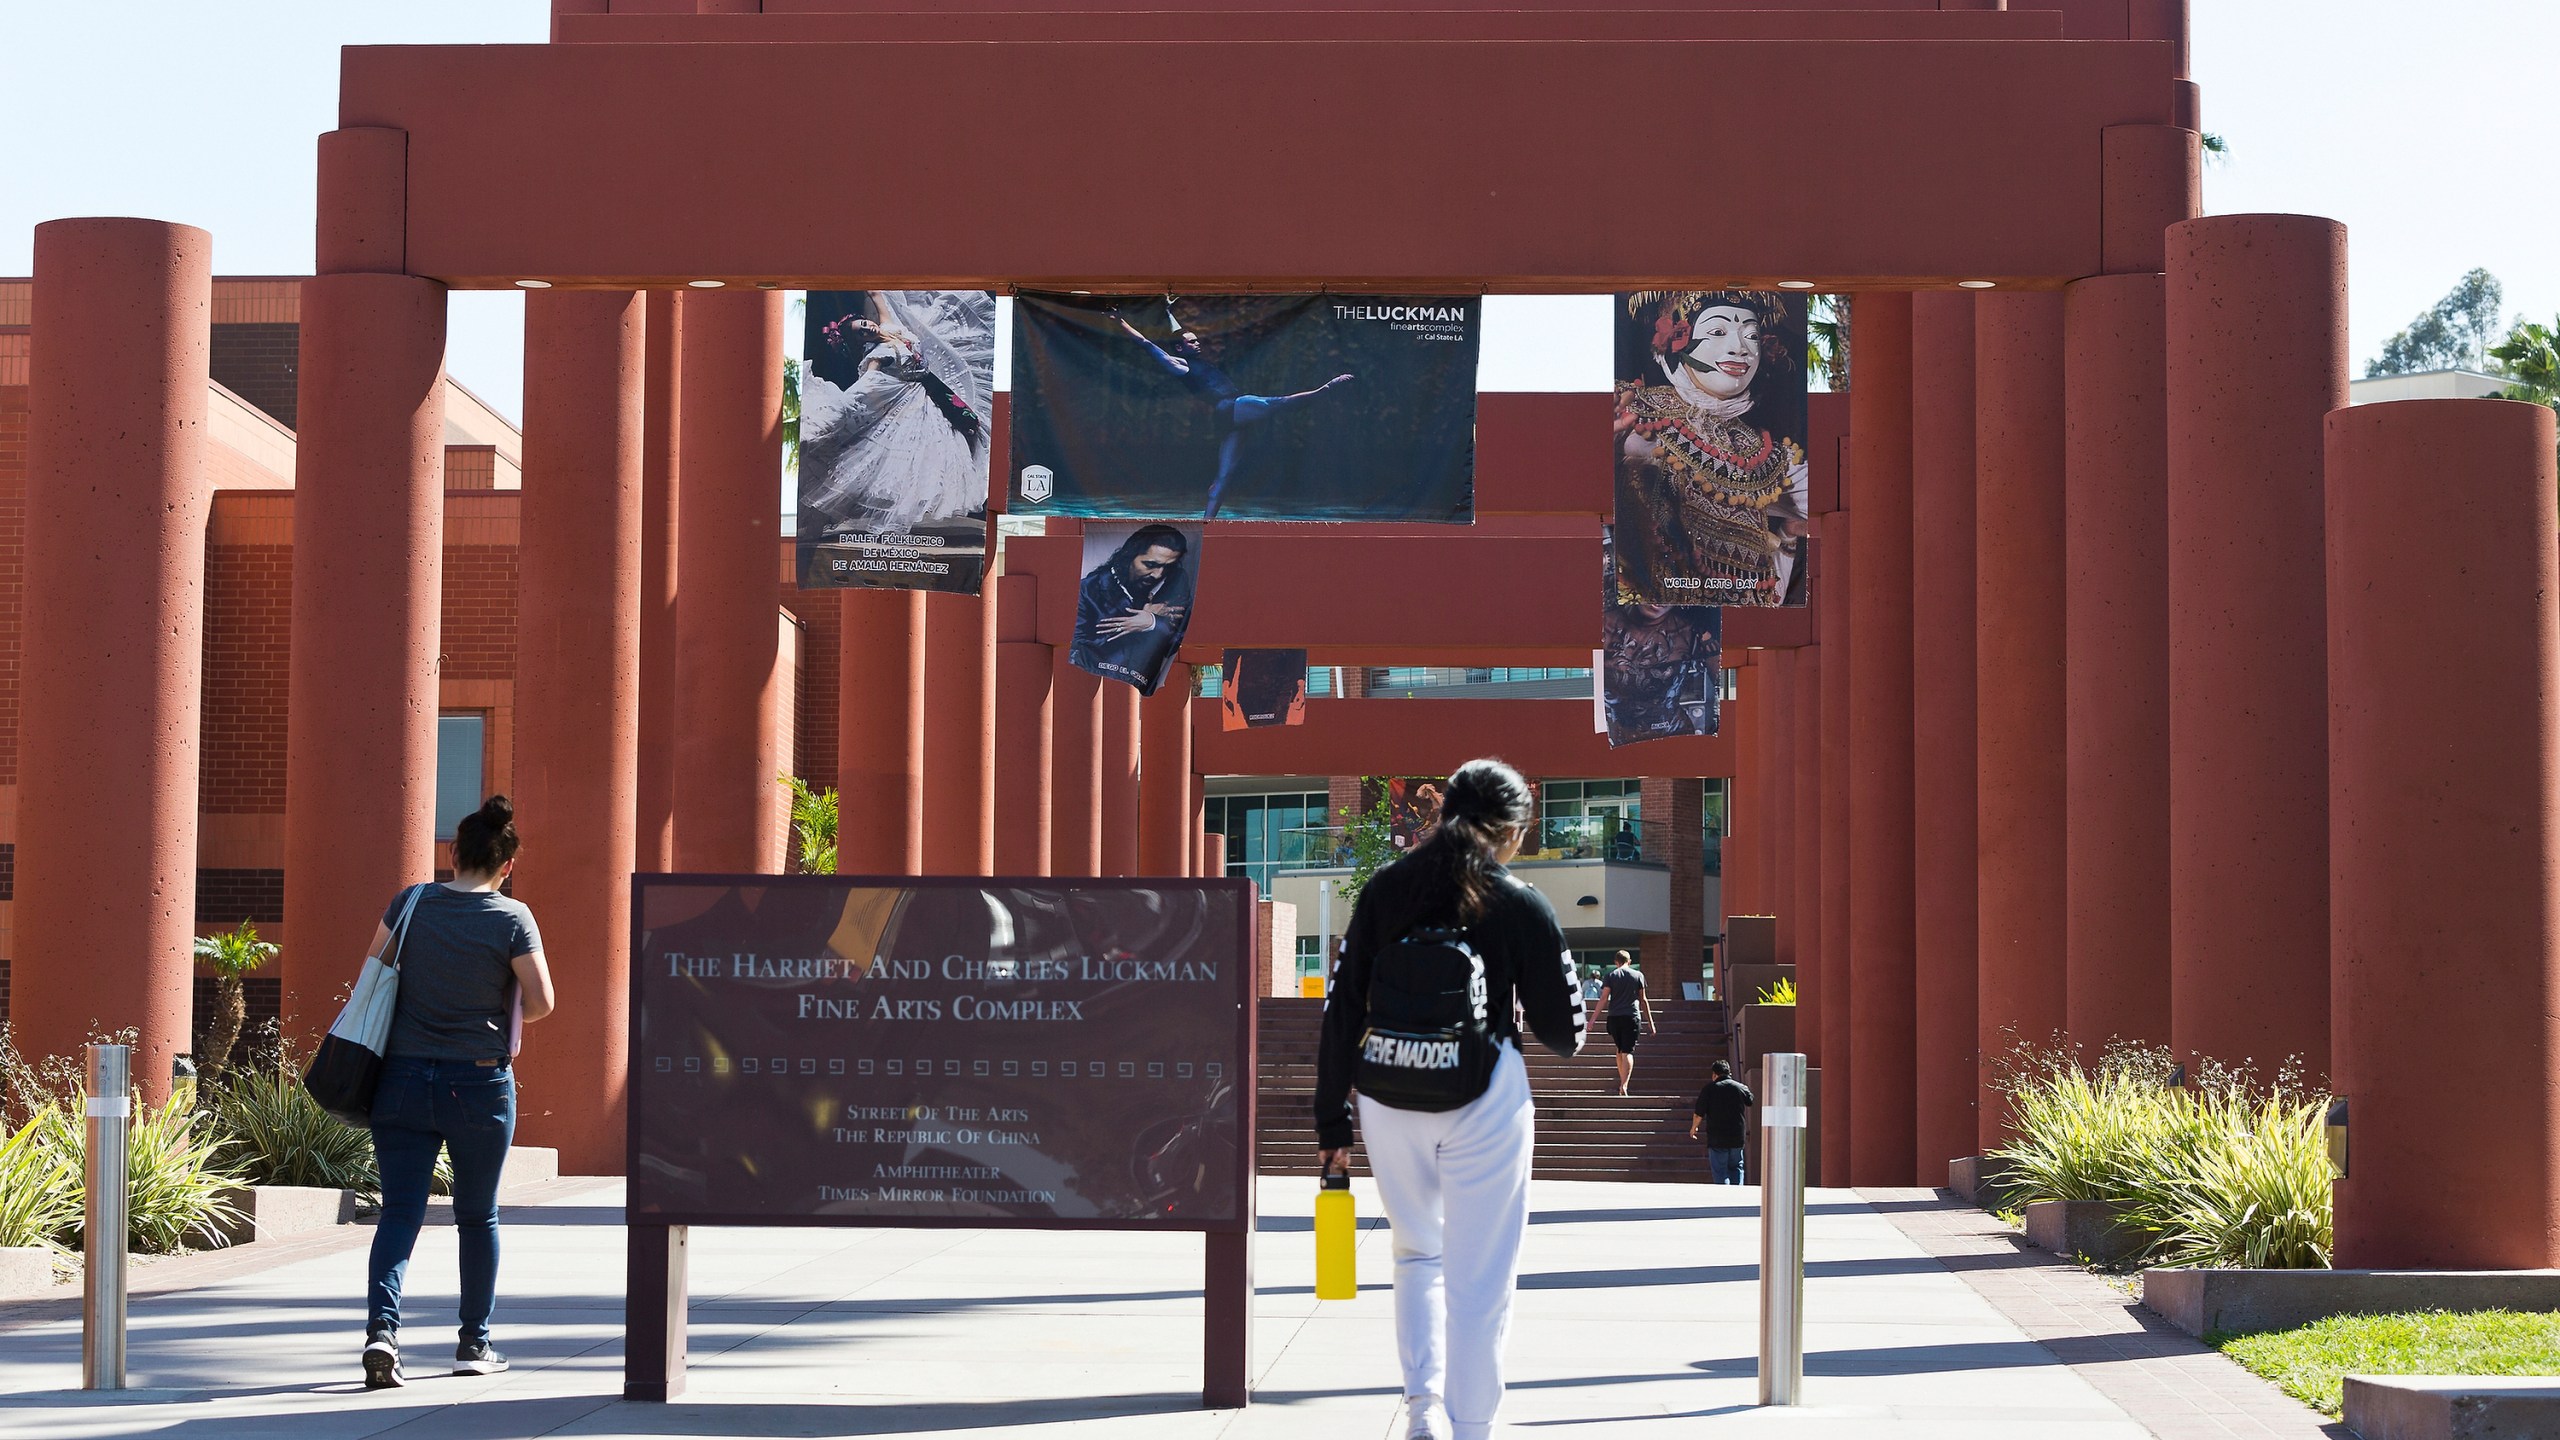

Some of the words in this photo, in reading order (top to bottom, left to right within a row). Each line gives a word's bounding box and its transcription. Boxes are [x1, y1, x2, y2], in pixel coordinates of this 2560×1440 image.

[1333, 306, 1465, 321] THELUCKMAN
[1390, 322, 1464, 333] fineartscomplex
[1027, 479, 1046, 491] LA
[840, 534, 879, 544] BALLET
[863, 548, 878, 558] DE
[880, 546, 920, 559] MÉXICO
[833, 560, 847, 570] DE
[849, 560, 887, 571] AMALIA
[890, 560, 949, 574] HERNÁNDEZ
[1664, 578, 1701, 588] WORLD
[1704, 578, 1733, 589] ARTS
[1736, 579, 1758, 589] DAY
[664, 953, 721, 978] THE
[731, 953, 855, 979] HARRIET
[865, 954, 931, 980] AND
[941, 954, 1069, 981] CHARLES
[1080, 956, 1218, 982] LUCKMAN
[797, 994, 860, 1019] FINE
[869, 995, 942, 1020] ARTS
[952, 995, 1084, 1021] COMPLEX
[1394, 1040, 1460, 1069] MADDEN
[847, 1105, 909, 1121] STREET
[914, 1105, 940, 1121] OF
[945, 1105, 980, 1121] THE
[986, 1106, 1029, 1122] ARTS
[833, 1127, 867, 1143] THE
[873, 1128, 951, 1144] REPUBLIC
[956, 1128, 983, 1144] OF
[987, 1129, 1041, 1145] CHINA
[872, 1163, 1001, 1180] AMPHITHEATER
[951, 1187, 1056, 1203] FOUNDATION
